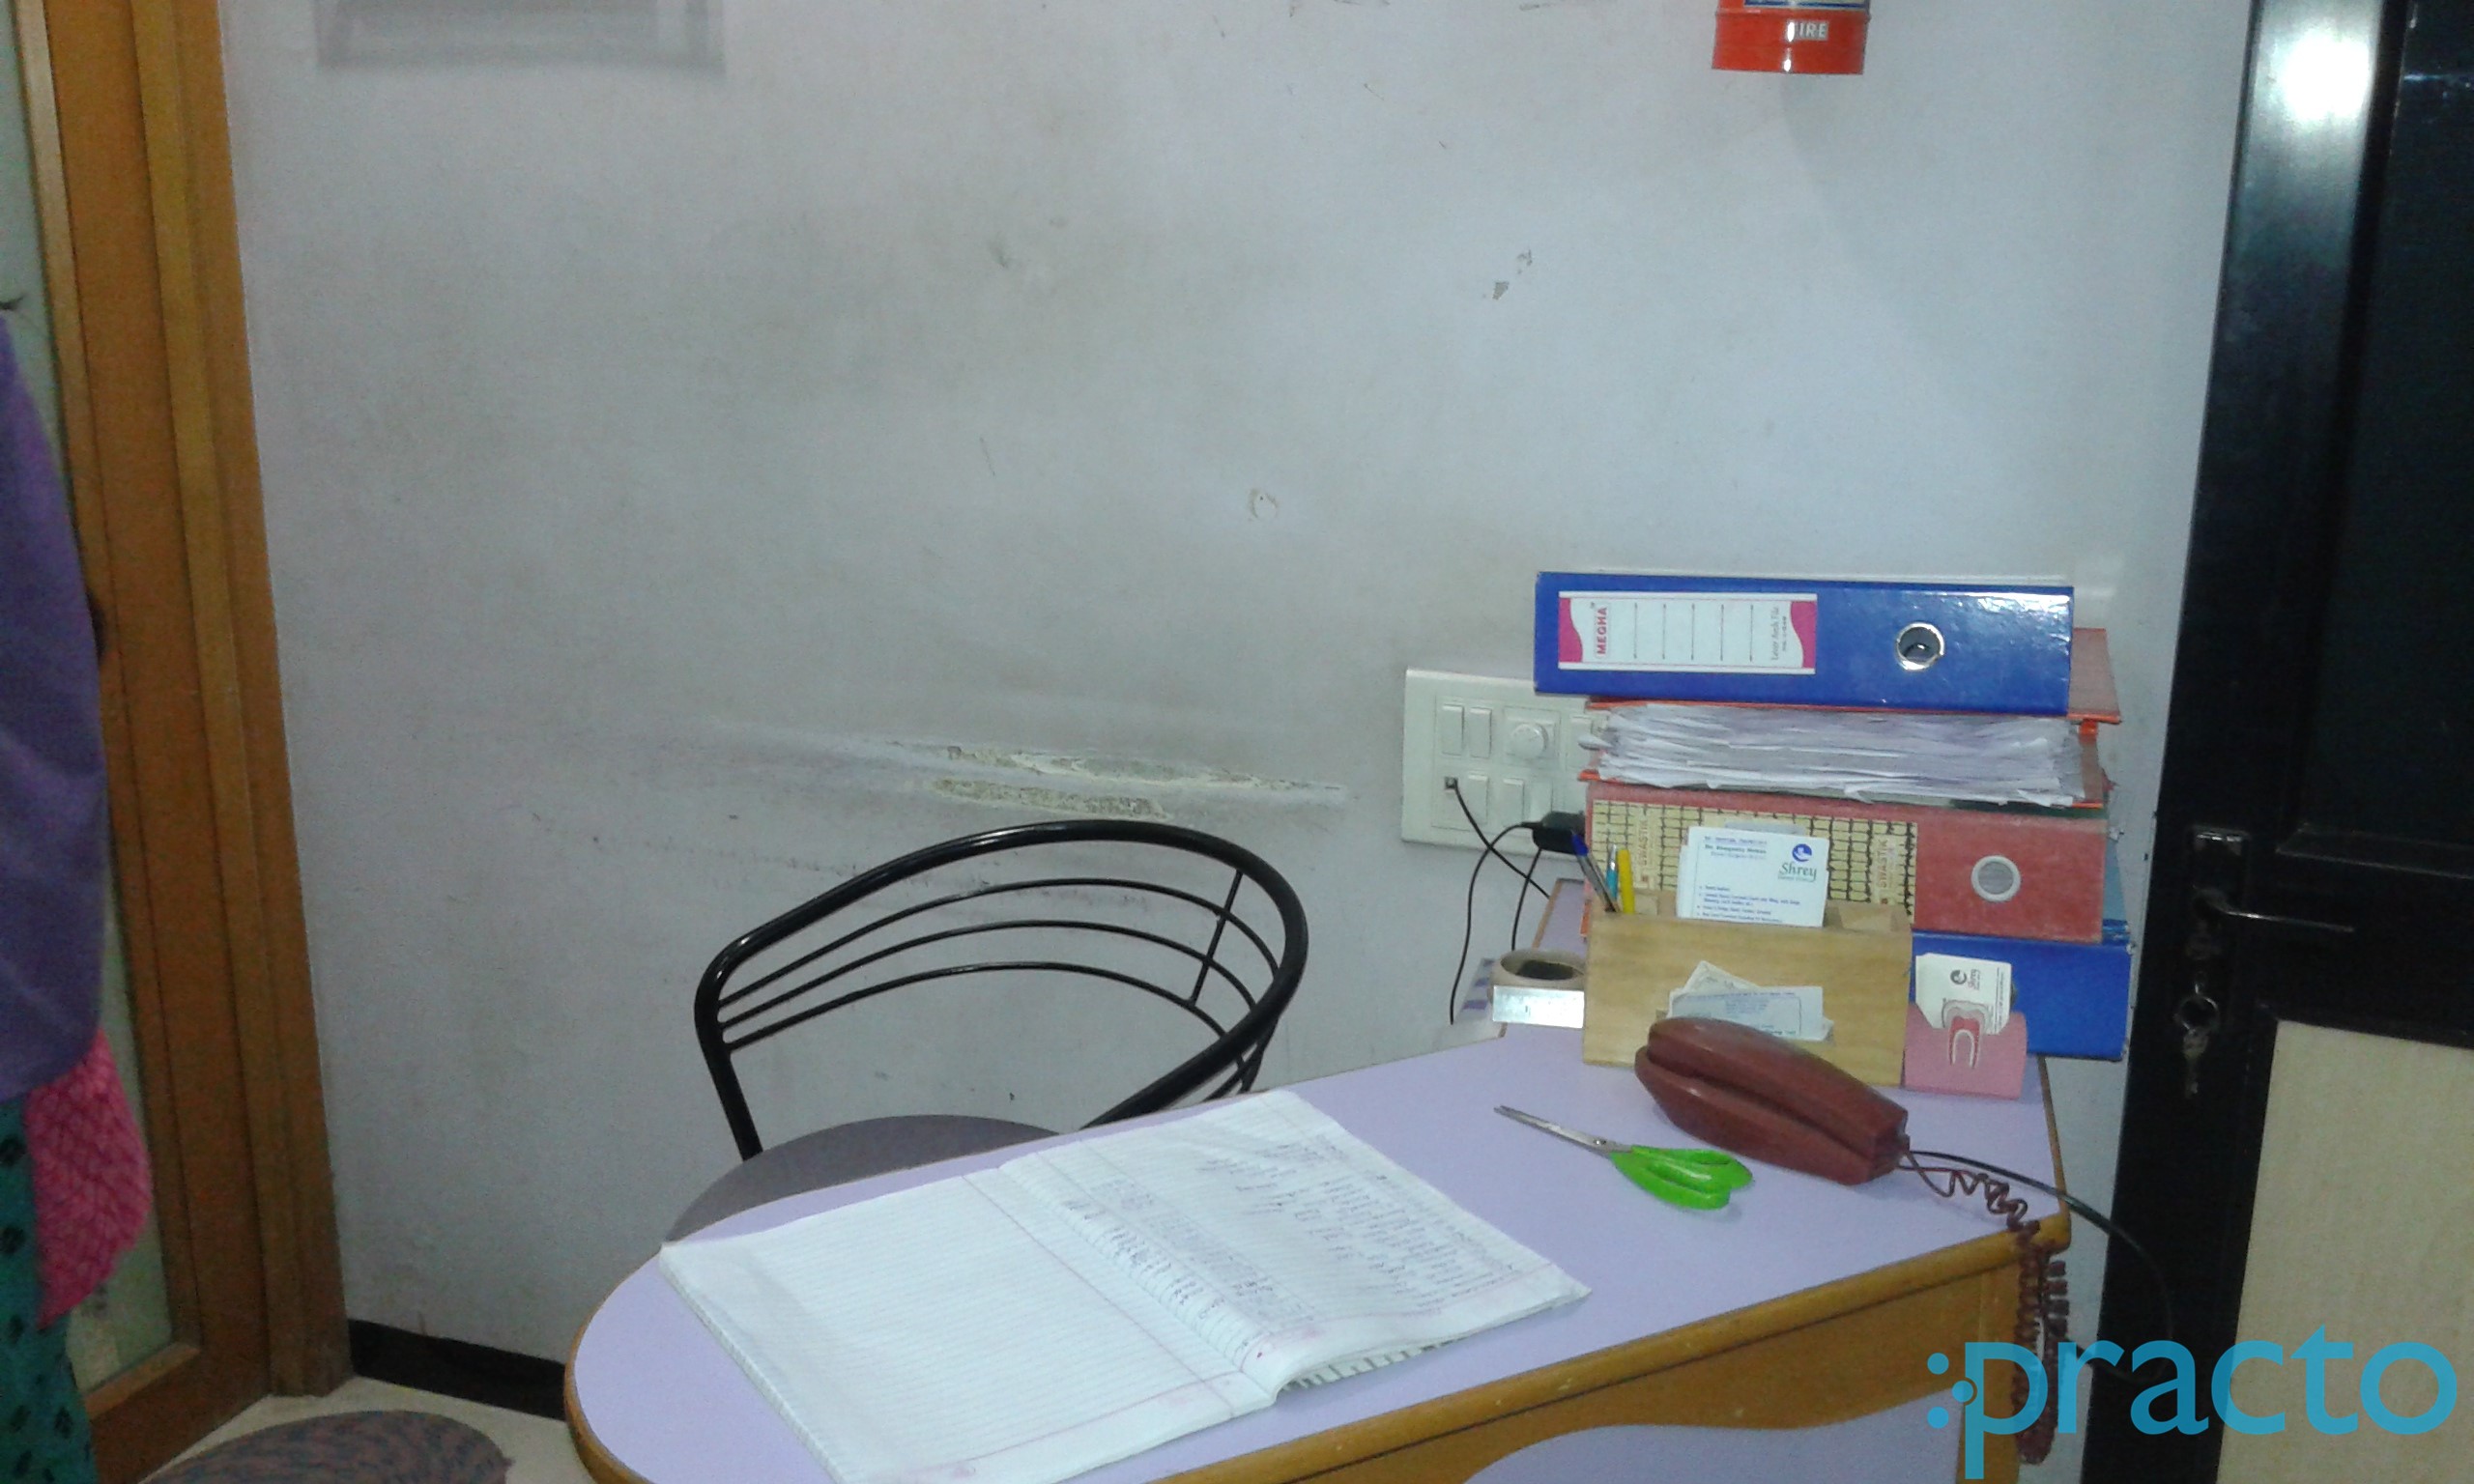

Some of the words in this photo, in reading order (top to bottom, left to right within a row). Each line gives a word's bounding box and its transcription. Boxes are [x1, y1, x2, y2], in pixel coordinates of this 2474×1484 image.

[1788, 21, 1827, 39] IRE
[1597, 607, 1607, 655] MEGHA
[1779, 861, 1817, 882] Shrey
[1878, 839, 1887, 888] SWASTIK
